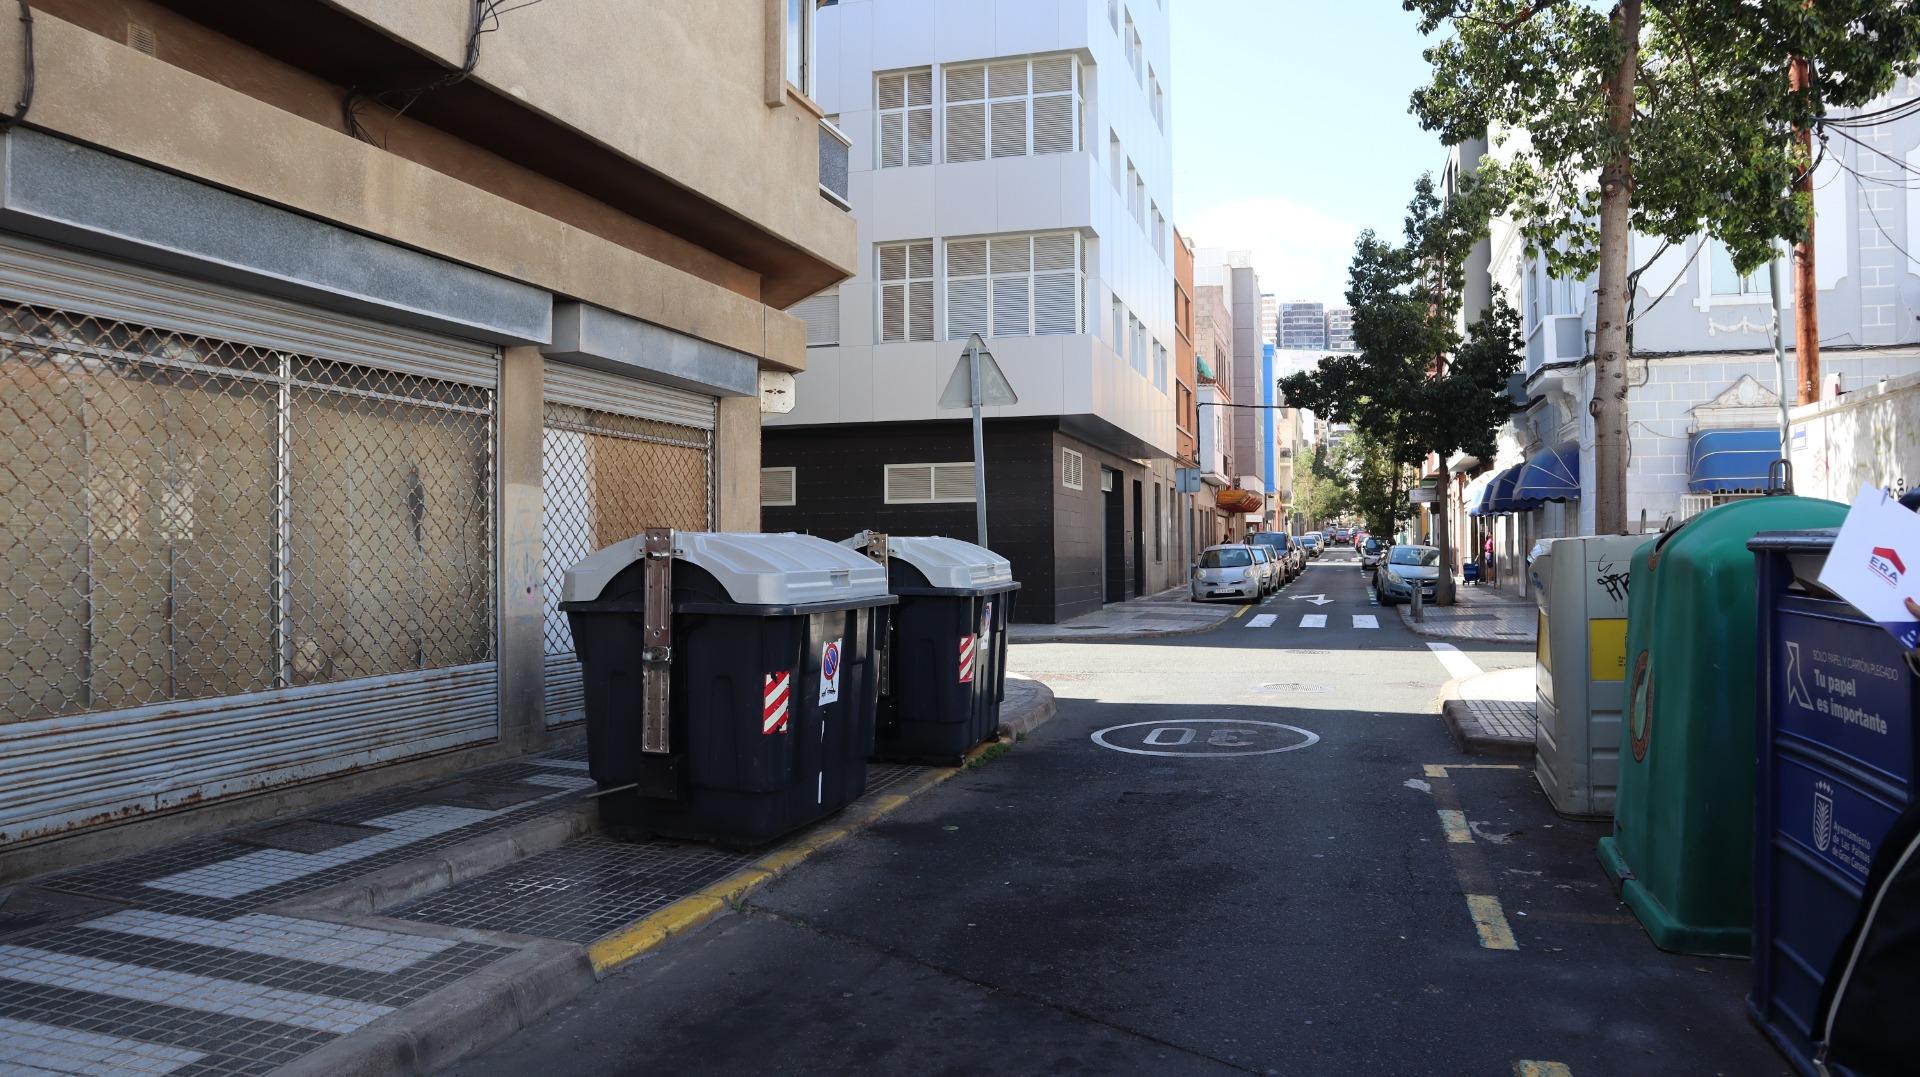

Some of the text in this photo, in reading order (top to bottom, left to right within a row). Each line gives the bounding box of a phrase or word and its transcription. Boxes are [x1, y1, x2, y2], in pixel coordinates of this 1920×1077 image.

[1869, 556, 1898, 583] ERA
[1828, 652, 1841, 666] PAPEL
[1870, 663, 1898, 680] PLEGADO
[1814, 668, 1856, 697] Tu papel
[1817, 697, 1887, 734] es importante
[1142, 727, 1258, 746] 30
[1833, 821, 1871, 850] Ayuntamiento
[1833, 833, 1870, 864] de Las Palmas
[1832, 847, 1838, 857] de
[1839, 850, 1850, 865] Gran
